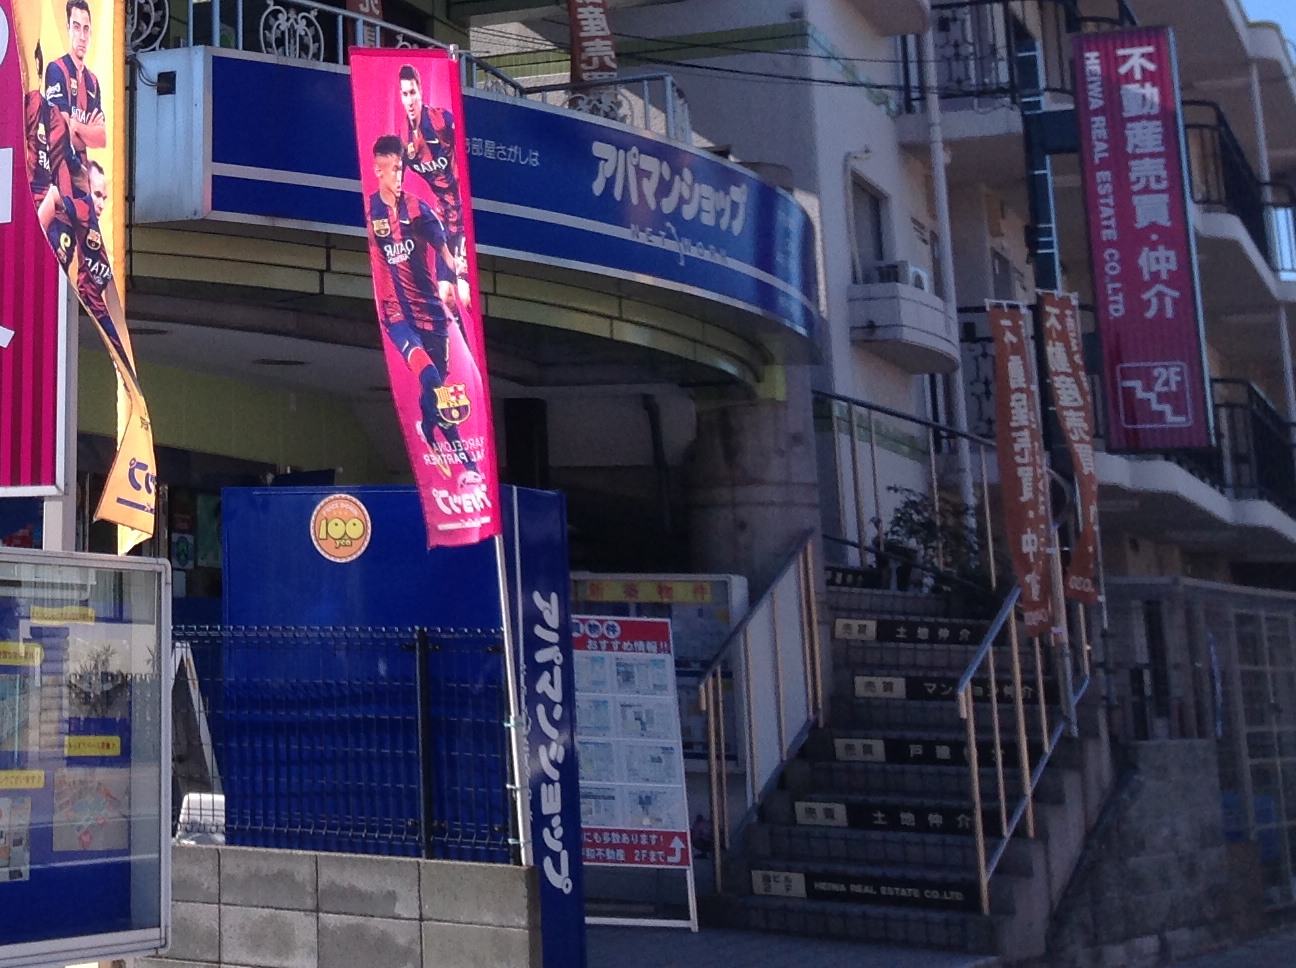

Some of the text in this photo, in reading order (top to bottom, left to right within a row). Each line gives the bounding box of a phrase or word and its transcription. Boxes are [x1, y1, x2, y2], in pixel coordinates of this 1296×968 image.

[1082, 51, 1105, 112] HEIWA
[1090, 115, 1111, 164] REAL
[591, 140, 749, 237] アパマンショップ
[1094, 170, 1118, 242] ESTATE
[1115, 44, 1181, 320] 不動産売買・仲介
[1152, 365, 1183, 395] 2F
[318, 517, 365, 541] 100
[334, 539, 352, 550] yen
[533, 590, 573, 895] アパマンショップ
